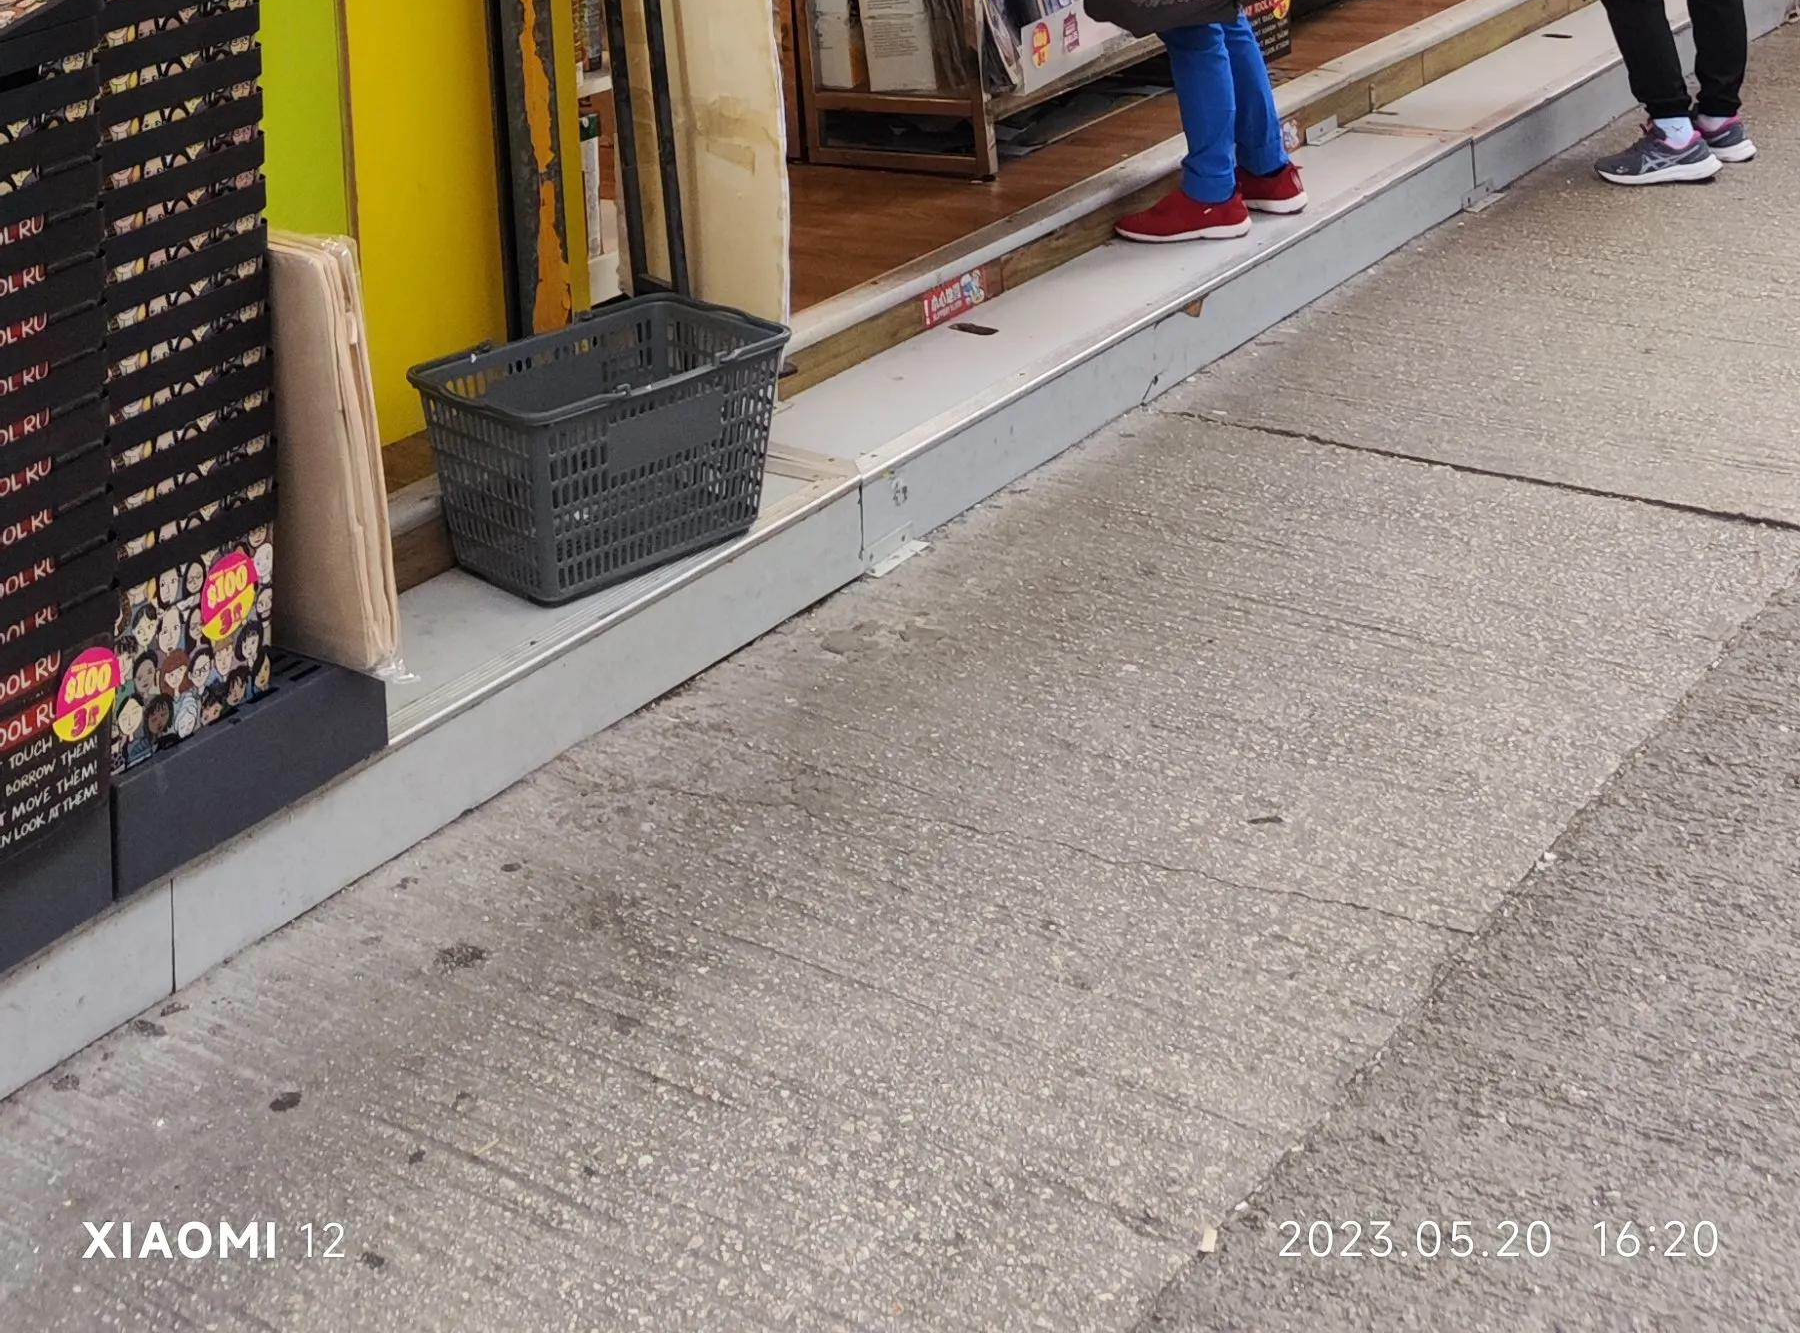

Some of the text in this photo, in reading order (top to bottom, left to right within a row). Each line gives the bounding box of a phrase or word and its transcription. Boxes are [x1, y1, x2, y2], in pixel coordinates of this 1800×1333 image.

[206, 564, 248, 609] $100
[64, 662, 112, 704] $100
[5, 734, 98, 797] BORROW THEM!
[8, 735, 53, 769] TOUCH
[11, 760, 98, 821] MOVE THEM!
[14, 812, 46, 841] LOOK
[48, 803, 61, 823] AT
[63, 780, 99, 812] THEM!
